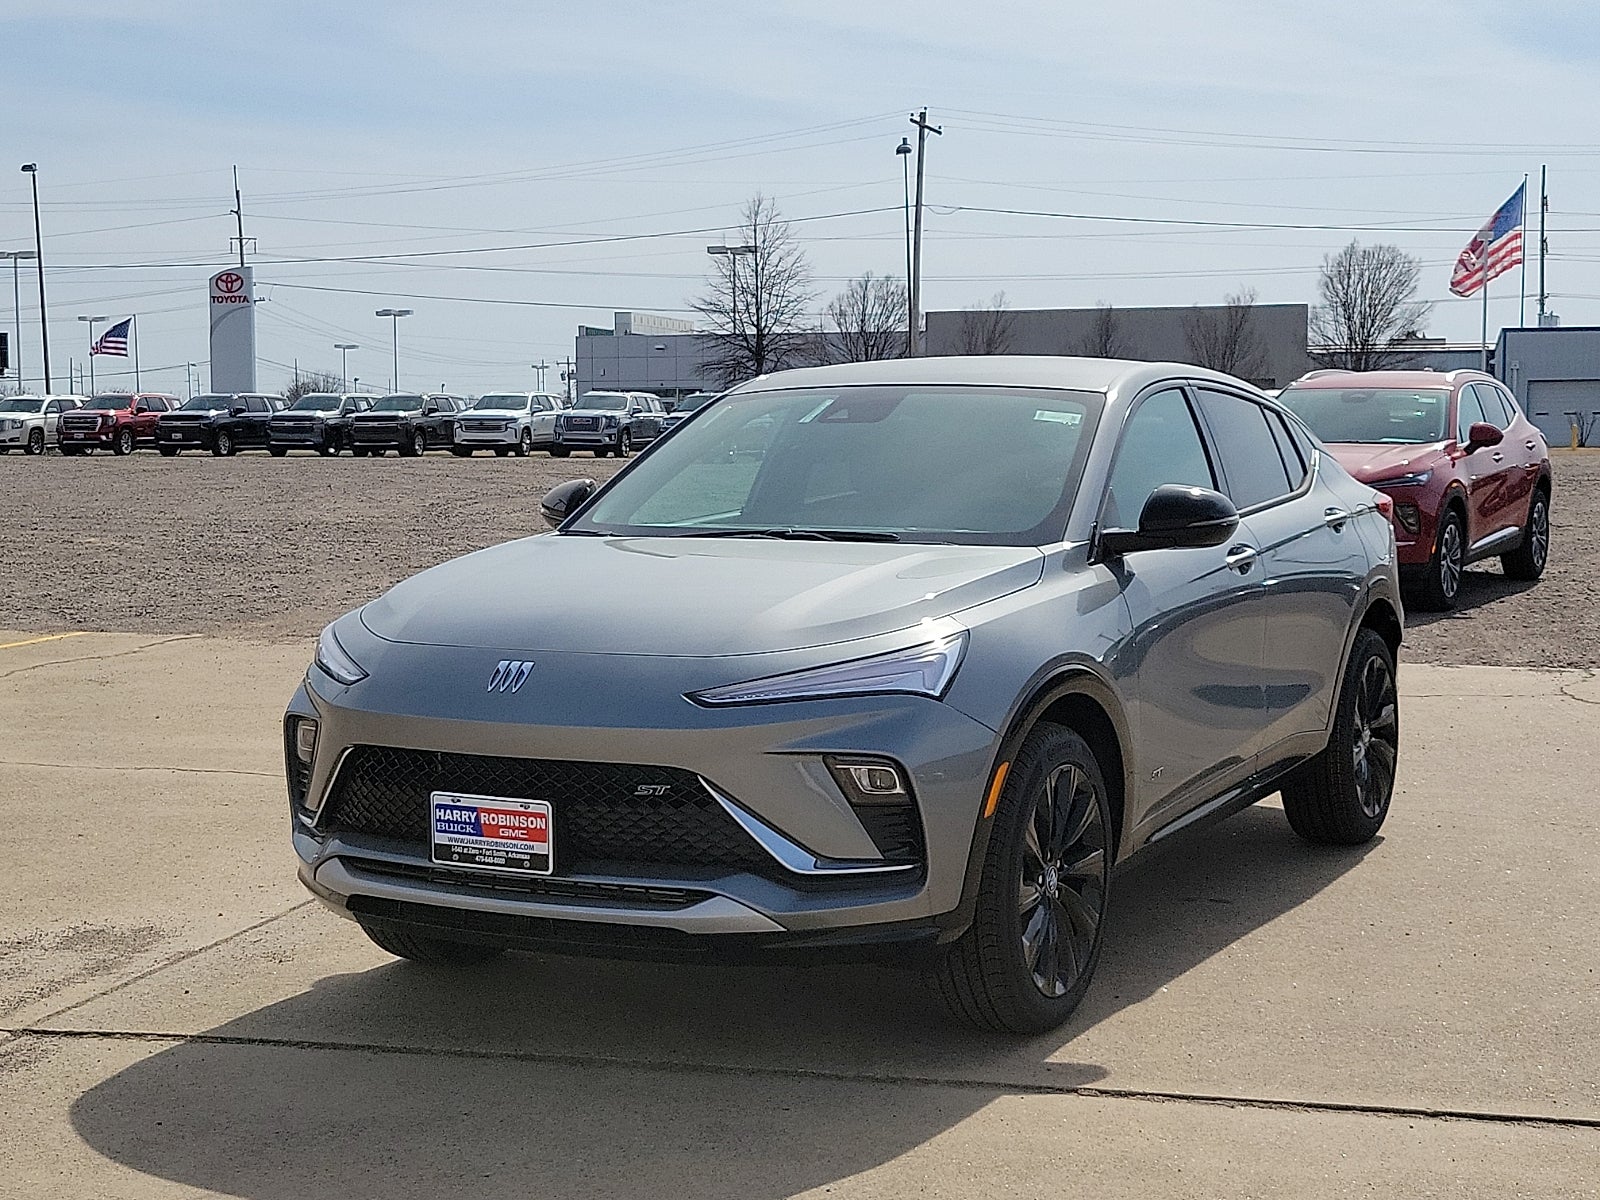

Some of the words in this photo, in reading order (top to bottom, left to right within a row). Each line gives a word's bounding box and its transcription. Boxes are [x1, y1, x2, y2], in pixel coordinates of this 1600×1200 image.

[211, 295, 250, 304] TOYOTA
[633, 784, 671, 796] ST
[435, 808, 477, 823] HARRY
[480, 812, 546, 830] ROBINSON
[436, 821, 476, 834] BUICK
[499, 828, 529, 839] GMC
[447, 836, 535, 851] WWW.HARRYROBINSON.COM
